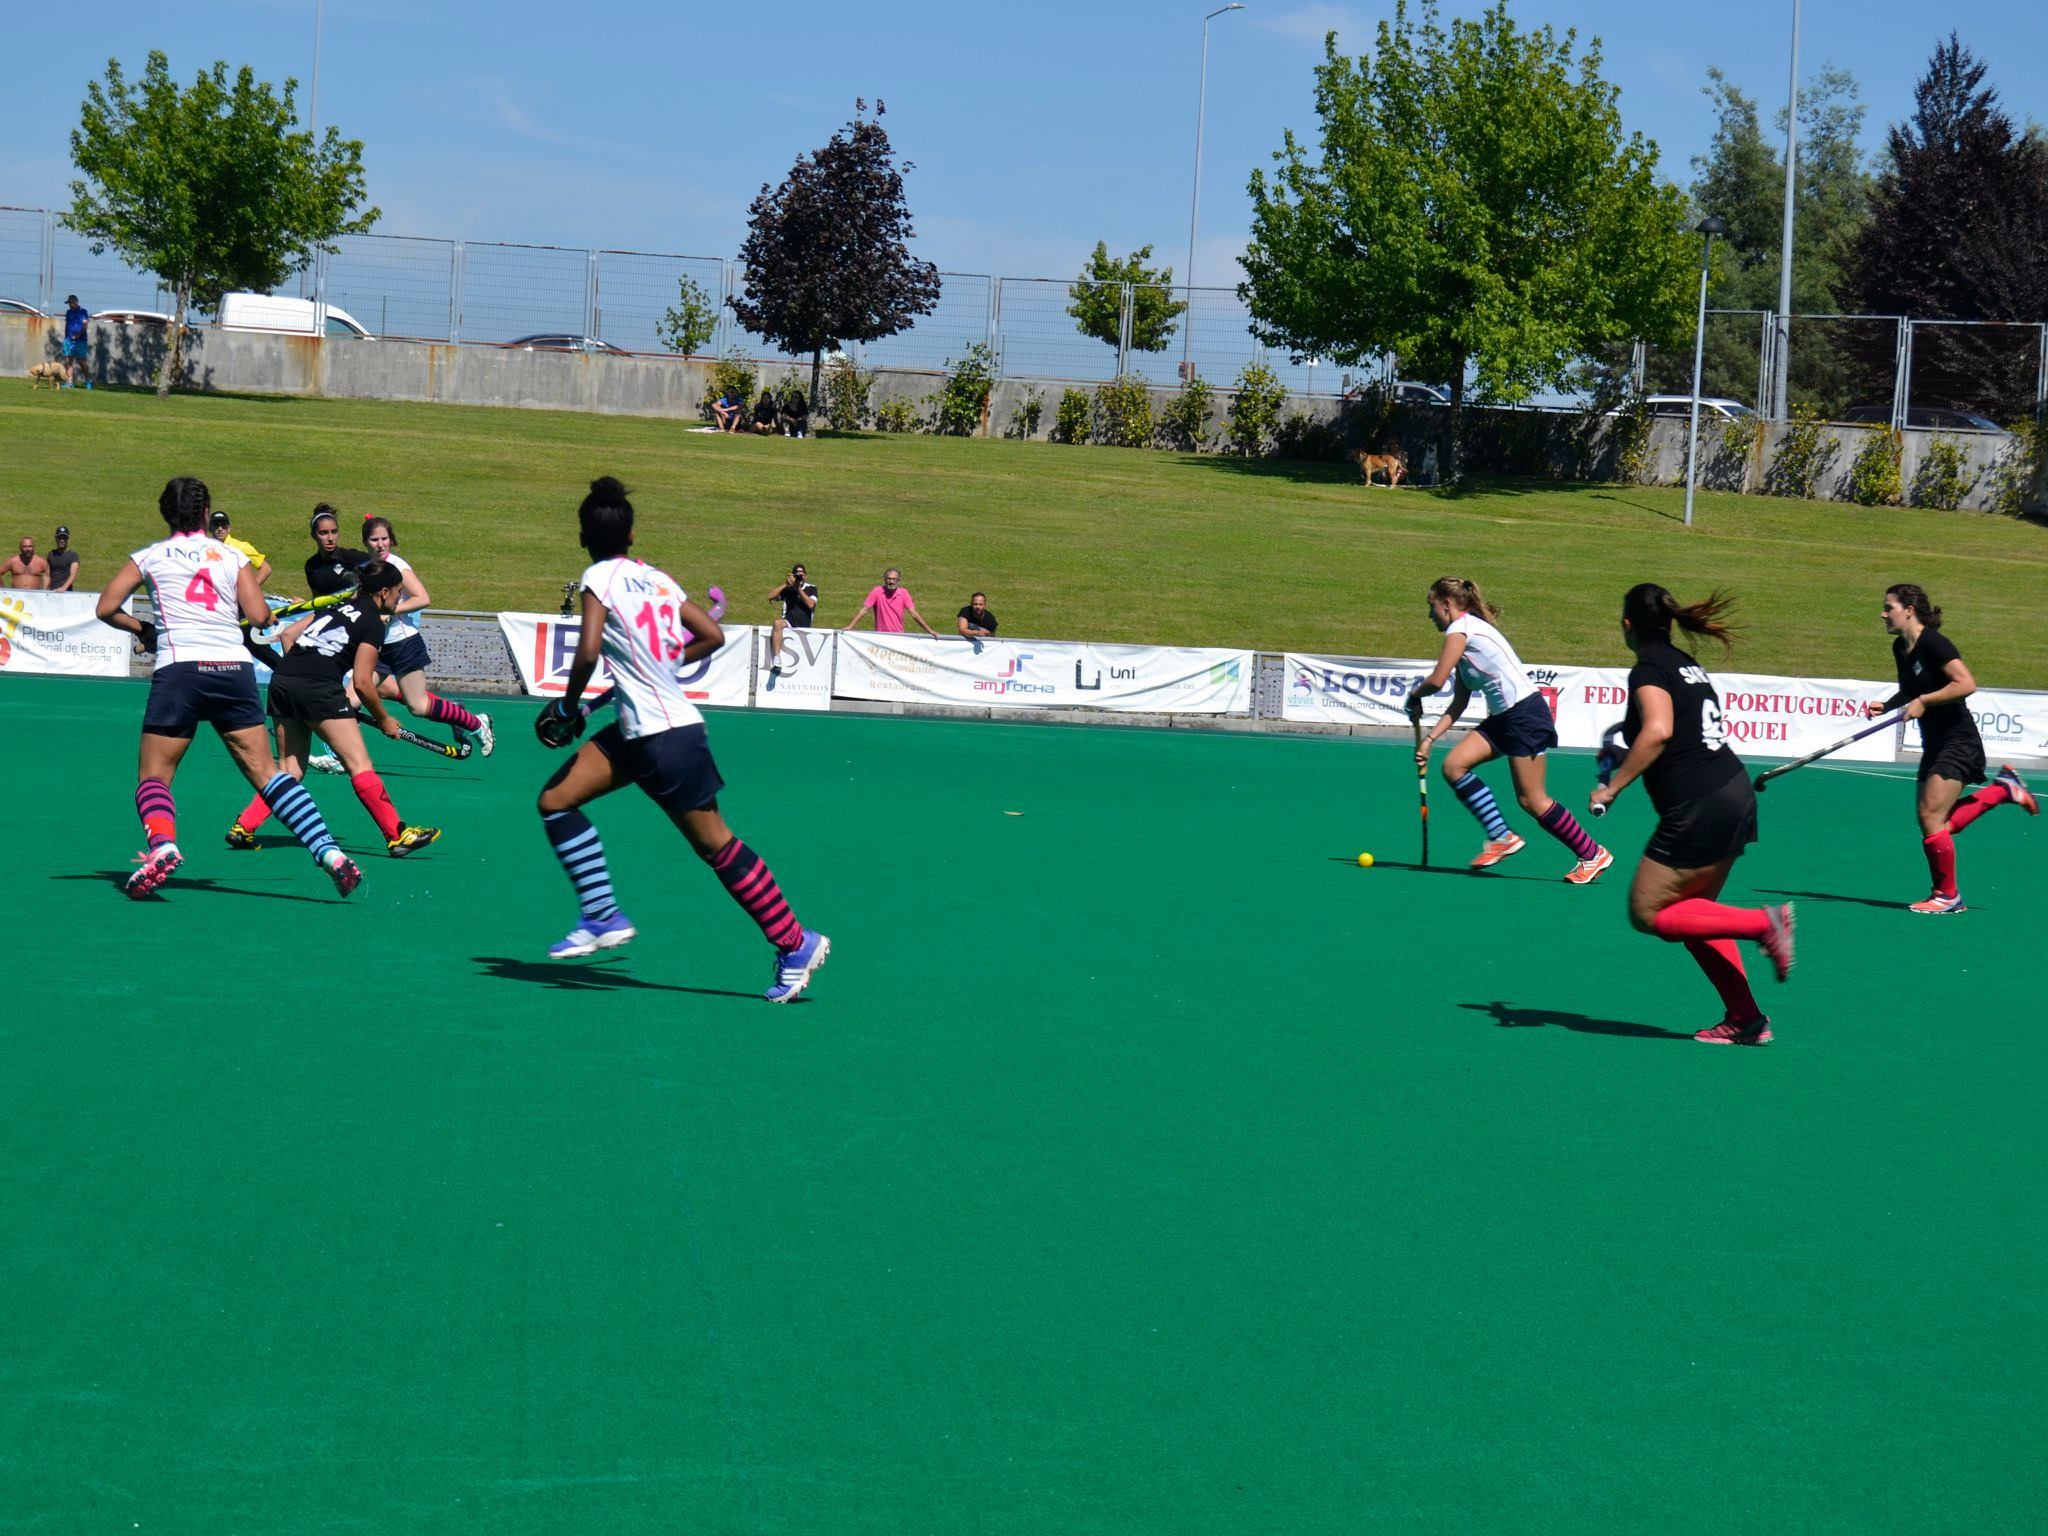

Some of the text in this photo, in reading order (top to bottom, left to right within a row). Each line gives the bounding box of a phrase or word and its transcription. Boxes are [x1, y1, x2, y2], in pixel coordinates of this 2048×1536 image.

[165, 548, 200, 562] ING
[185, 568, 219, 611] 4
[22, 626, 64, 643] Plano
[65, 643, 78, 654] de
[80, 641, 106, 654] Ética
[109, 646, 122, 655] no
[1321, 699, 1346, 708] Uma
[1350, 702, 1376, 710] nova
[1725, 692, 1870, 717] PORTUGUESA
[1981, 734, 2023, 742] Sportswear
